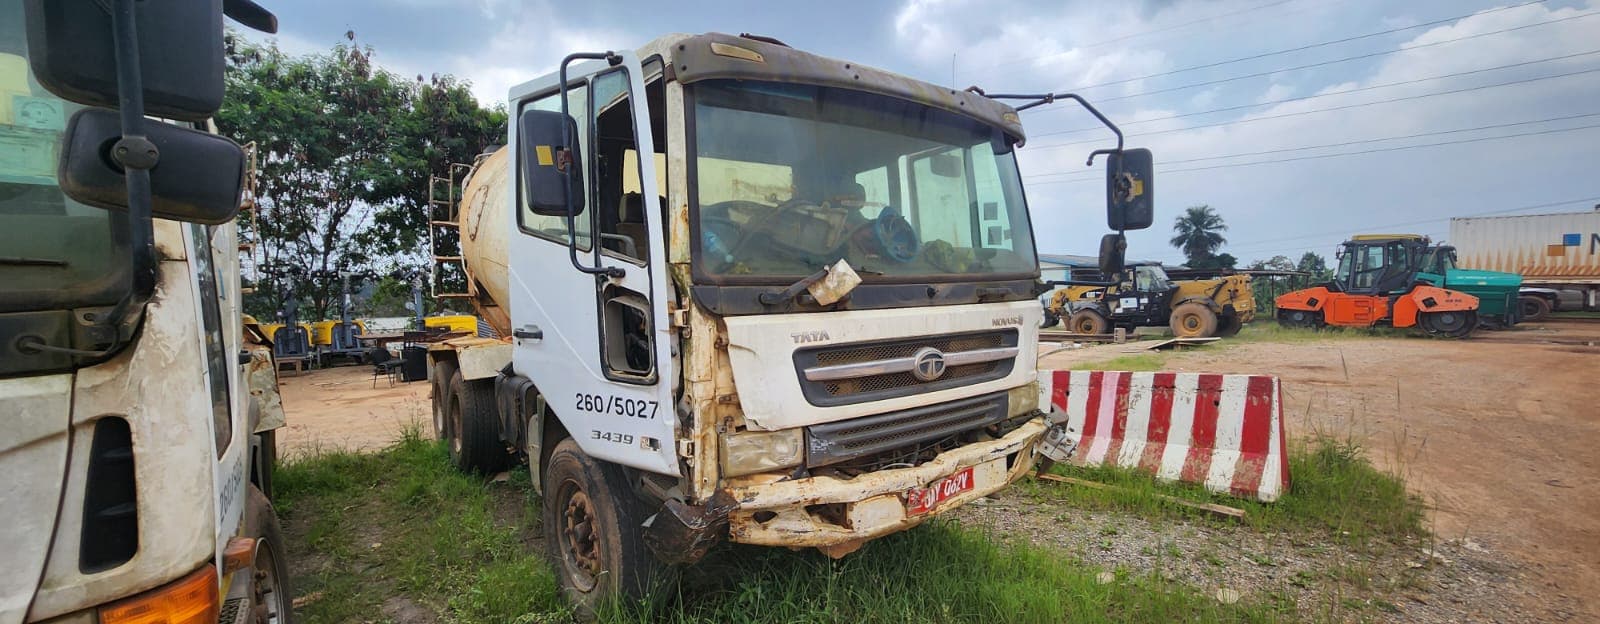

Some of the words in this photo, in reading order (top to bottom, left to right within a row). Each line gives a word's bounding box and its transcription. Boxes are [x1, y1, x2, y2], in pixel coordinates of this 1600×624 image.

[791, 329, 830, 343] TATA
[575, 393, 659, 419] 260/5027
[591, 430, 634, 445] 3439
